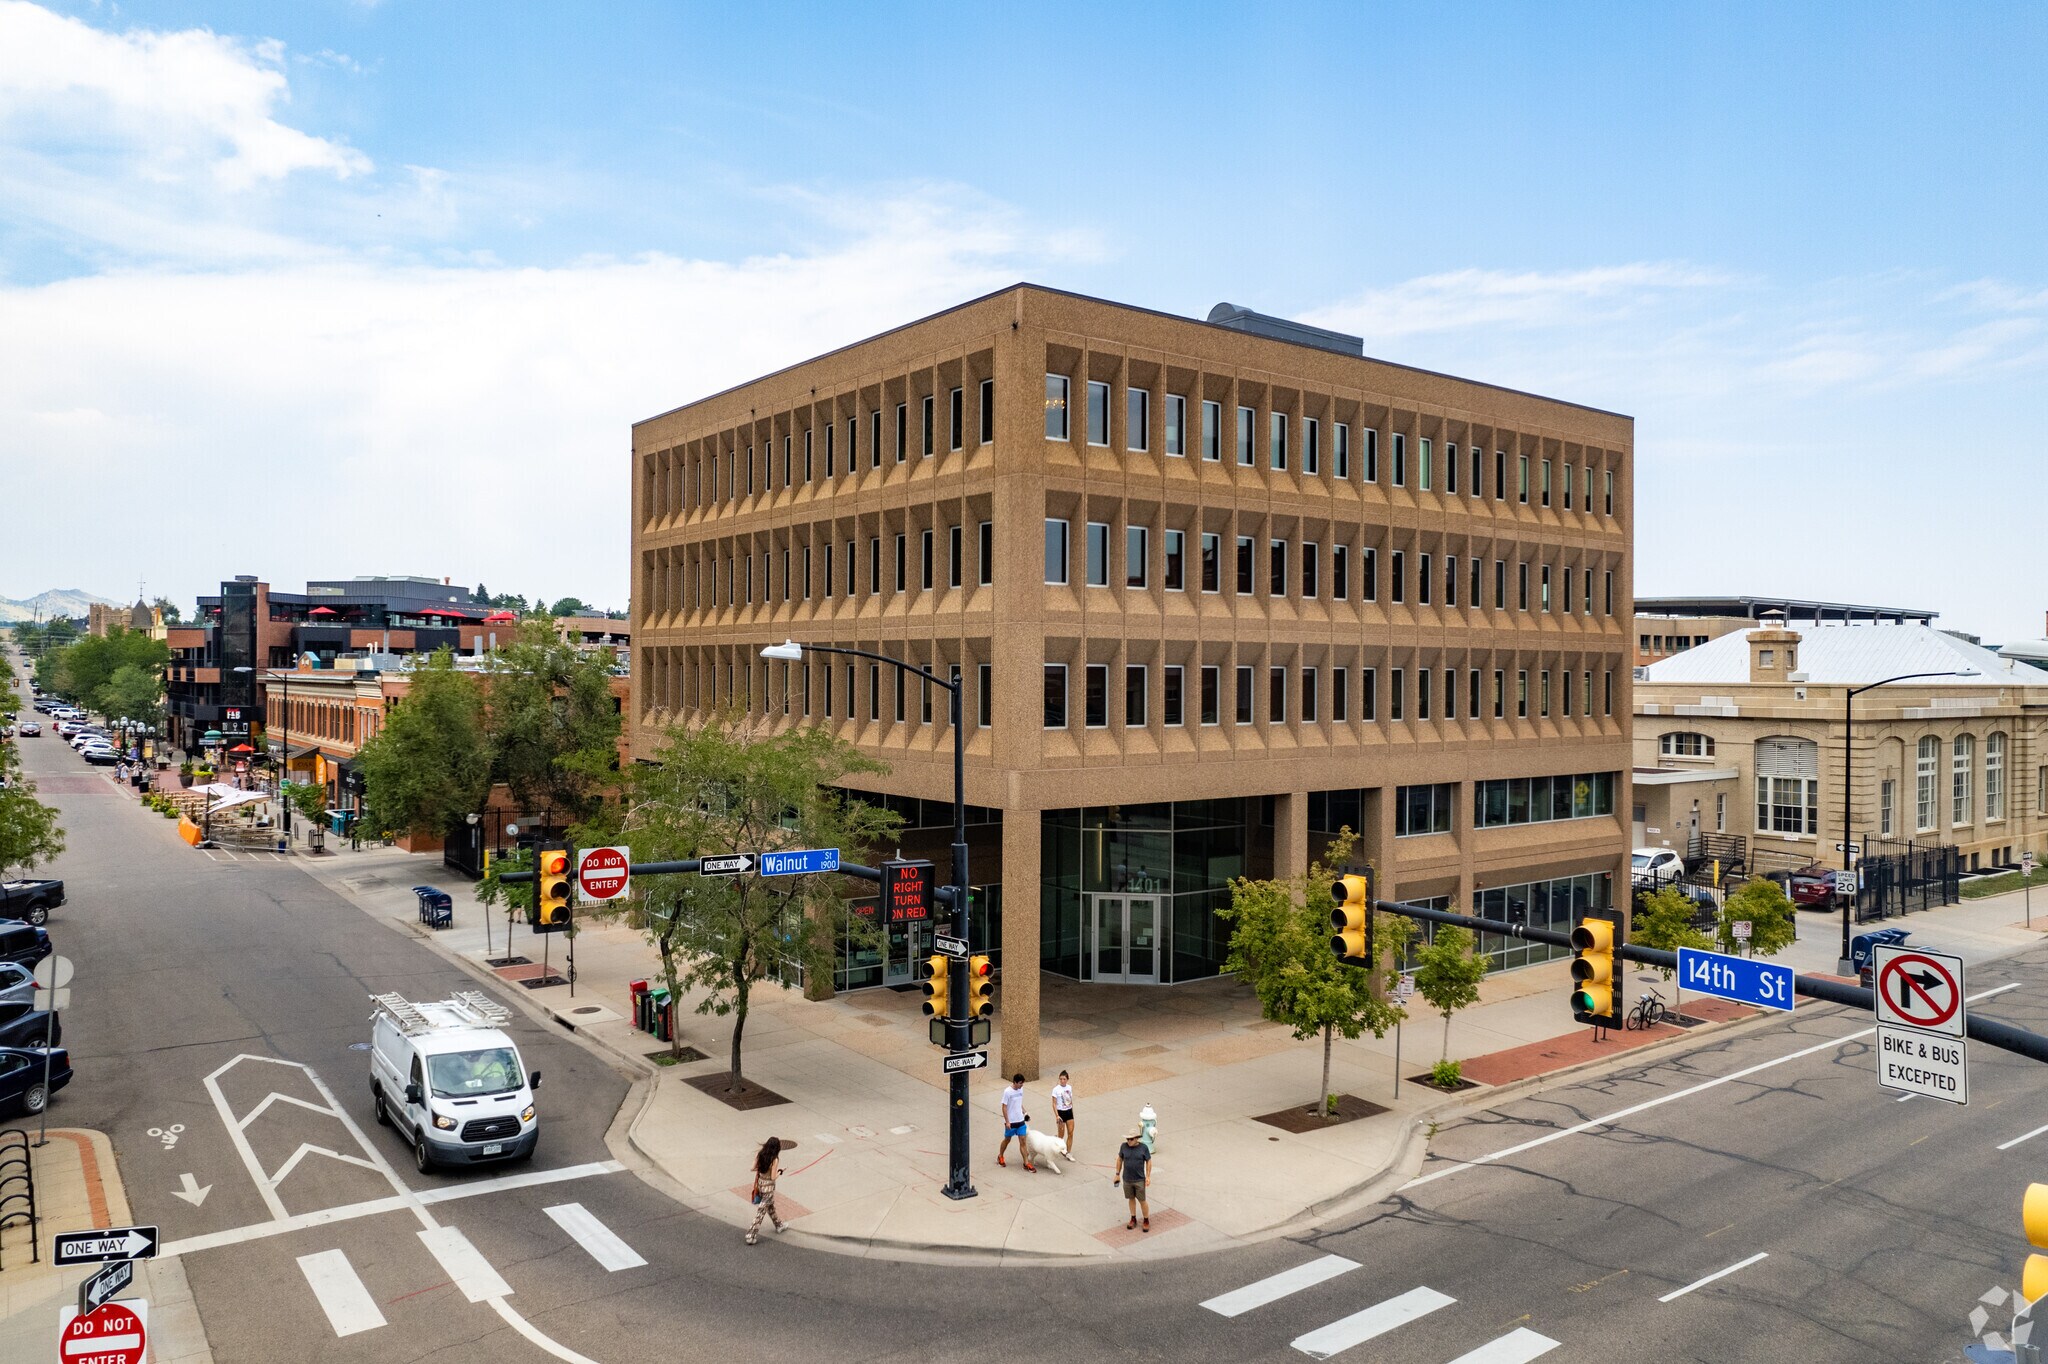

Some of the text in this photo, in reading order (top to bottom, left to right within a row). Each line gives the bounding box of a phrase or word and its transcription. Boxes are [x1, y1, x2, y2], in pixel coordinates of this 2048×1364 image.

[824, 852, 832, 860] St
[586, 857, 622, 868] DO NOT
[766, 855, 808, 872] Walnut
[821, 860, 836, 870] 1900
[900, 867, 918, 879] NO
[590, 880, 618, 890] ENTER
[894, 881, 923, 893] RIGHT
[1128, 878, 1160, 893] 1401
[1838, 882, 1854, 892] 20
[894, 895, 920, 905] TURN
[855, 906, 874, 915] OPEN
[906, 907, 926, 918] RED
[938, 940, 948, 948] ONE
[1688, 958, 1786, 1002] 14th St
[1884, 1036, 1960, 1065] BIKE & BUS
[948, 1060, 960, 1068] ONE
[1888, 1064, 1956, 1092] EXCEPTED
[66, 1238, 126, 1255] ONE WAY
[100, 1265, 130, 1294] ONE WAY
[74, 1317, 134, 1335] DO NOT
